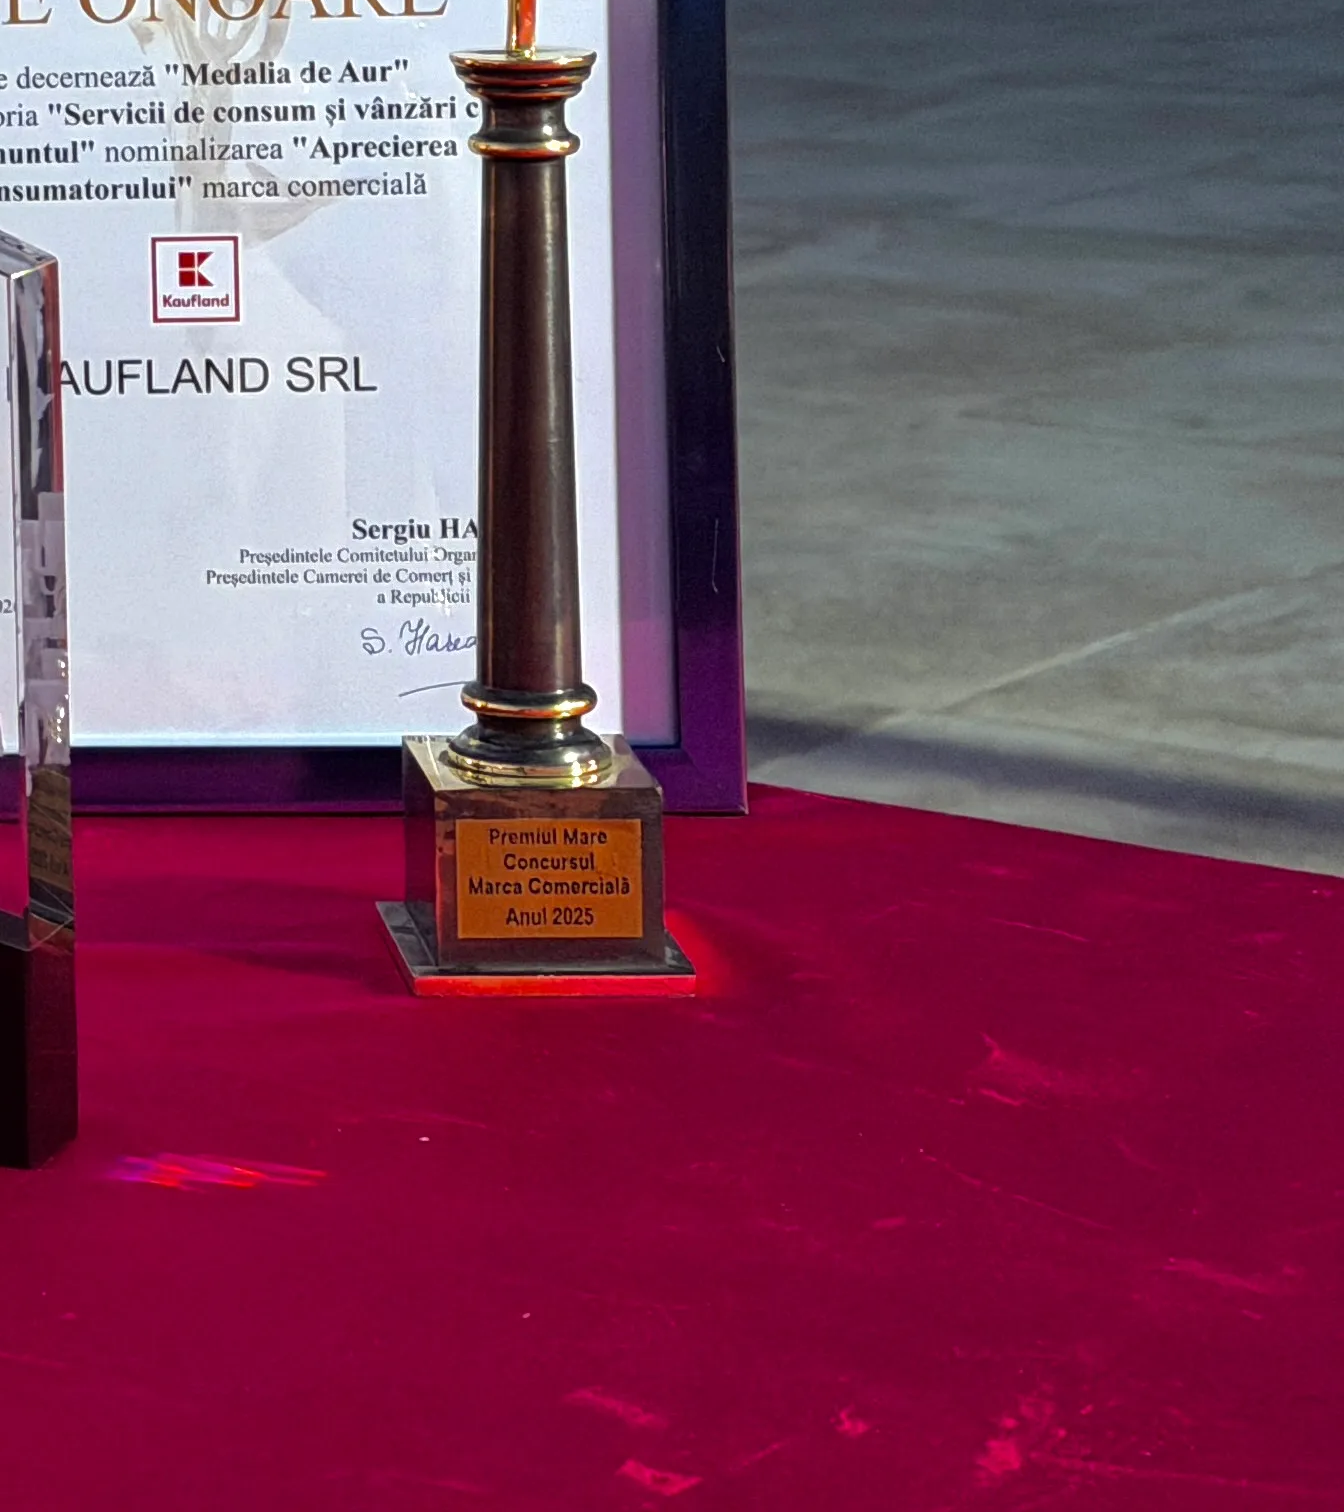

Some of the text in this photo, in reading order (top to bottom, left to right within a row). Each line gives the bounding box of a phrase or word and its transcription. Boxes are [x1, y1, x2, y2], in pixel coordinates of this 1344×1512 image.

[16, 65, 156, 90] decernează
[165, 61, 291, 86] "Medalia
[300, 61, 332, 84] de
[338, 59, 408, 84] Aur"
[48, 100, 166, 126] "Servicii
[174, 100, 205, 124] de
[213, 103, 316, 124] consum
[353, 95, 457, 121] vânzări
[105, 138, 283, 163] nominalizarea
[293, 134, 458, 165] "Aprecierea
[202, 179, 280, 199] marca
[287, 172, 428, 197] comercială
[162, 294, 230, 308] Kaufland
[60, 356, 378, 396] AUFLAND SRL
[352, 518, 430, 545] Sergiu
[337, 546, 429, 564] Comitetului
[303, 568, 368, 585] Camerei
[373, 567, 392, 584] de
[377, 588, 471, 608] a Republicii
[488, 827, 609, 846] Premiul Mare
[503, 852, 596, 871] Concursul
[468, 875, 631, 896] Marca Comercială
[505, 906, 595, 927] Anul 2025
